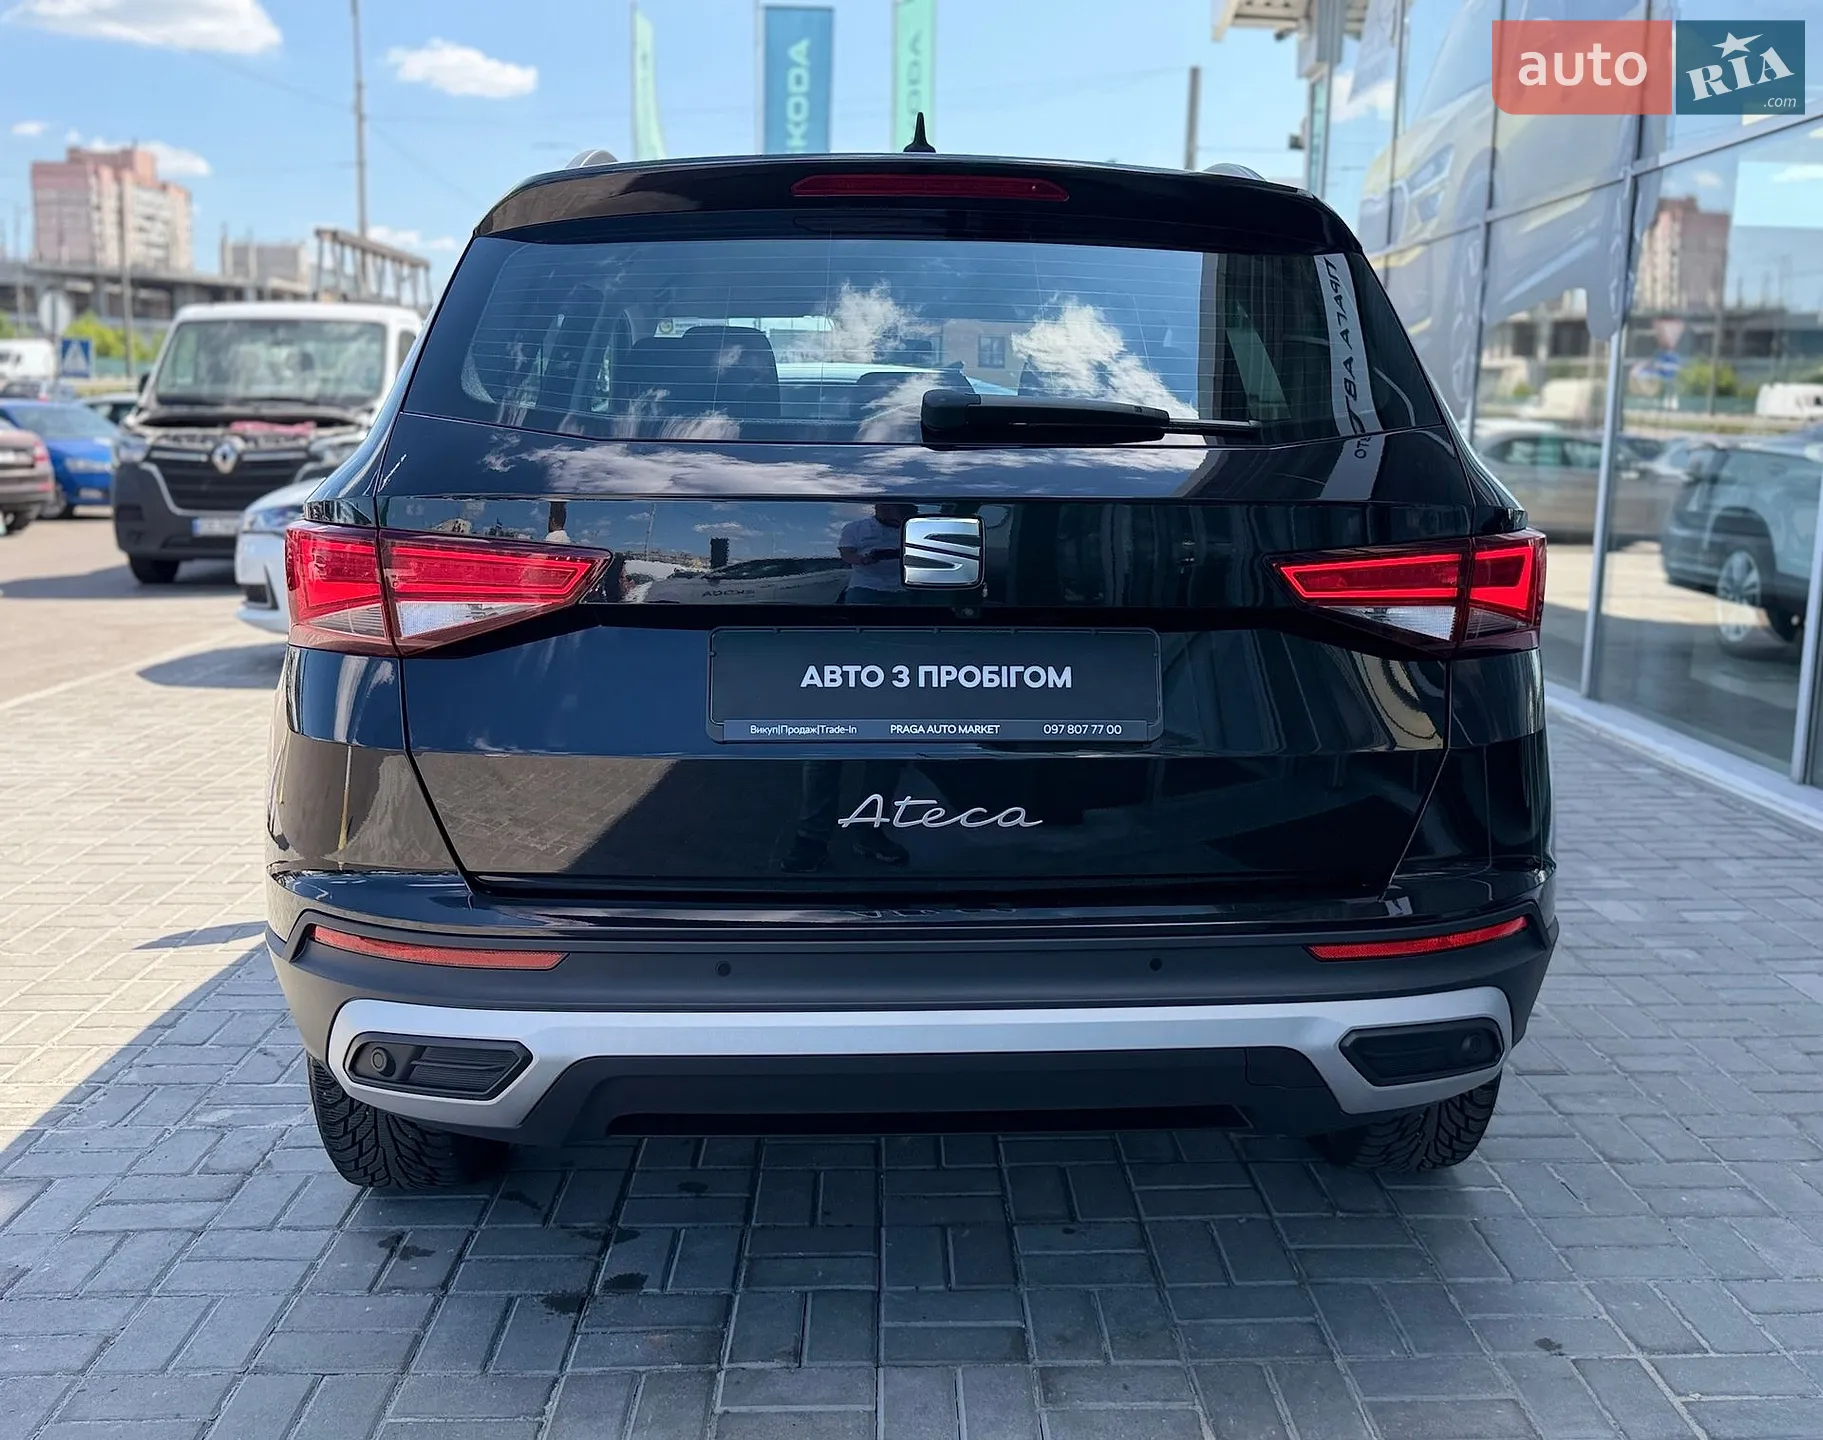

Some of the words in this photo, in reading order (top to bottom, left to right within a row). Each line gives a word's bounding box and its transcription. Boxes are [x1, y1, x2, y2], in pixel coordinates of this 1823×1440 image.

[785, 37, 811, 150] KODA
[800, 665, 885, 688] АВТО
[917, 665, 1073, 688] ПРОБІГОМ
[890, 724, 925, 734] PRAGA
[926, 724, 956, 734] AUTO
[958, 724, 1000, 734] MARKET
[1043, 724, 1065, 735] 097
[1067, 724, 1088, 735] 807
[1089, 724, 1104, 735] 77
[1106, 724, 1123, 735] 00
[838, 793, 1044, 829] Ateca
